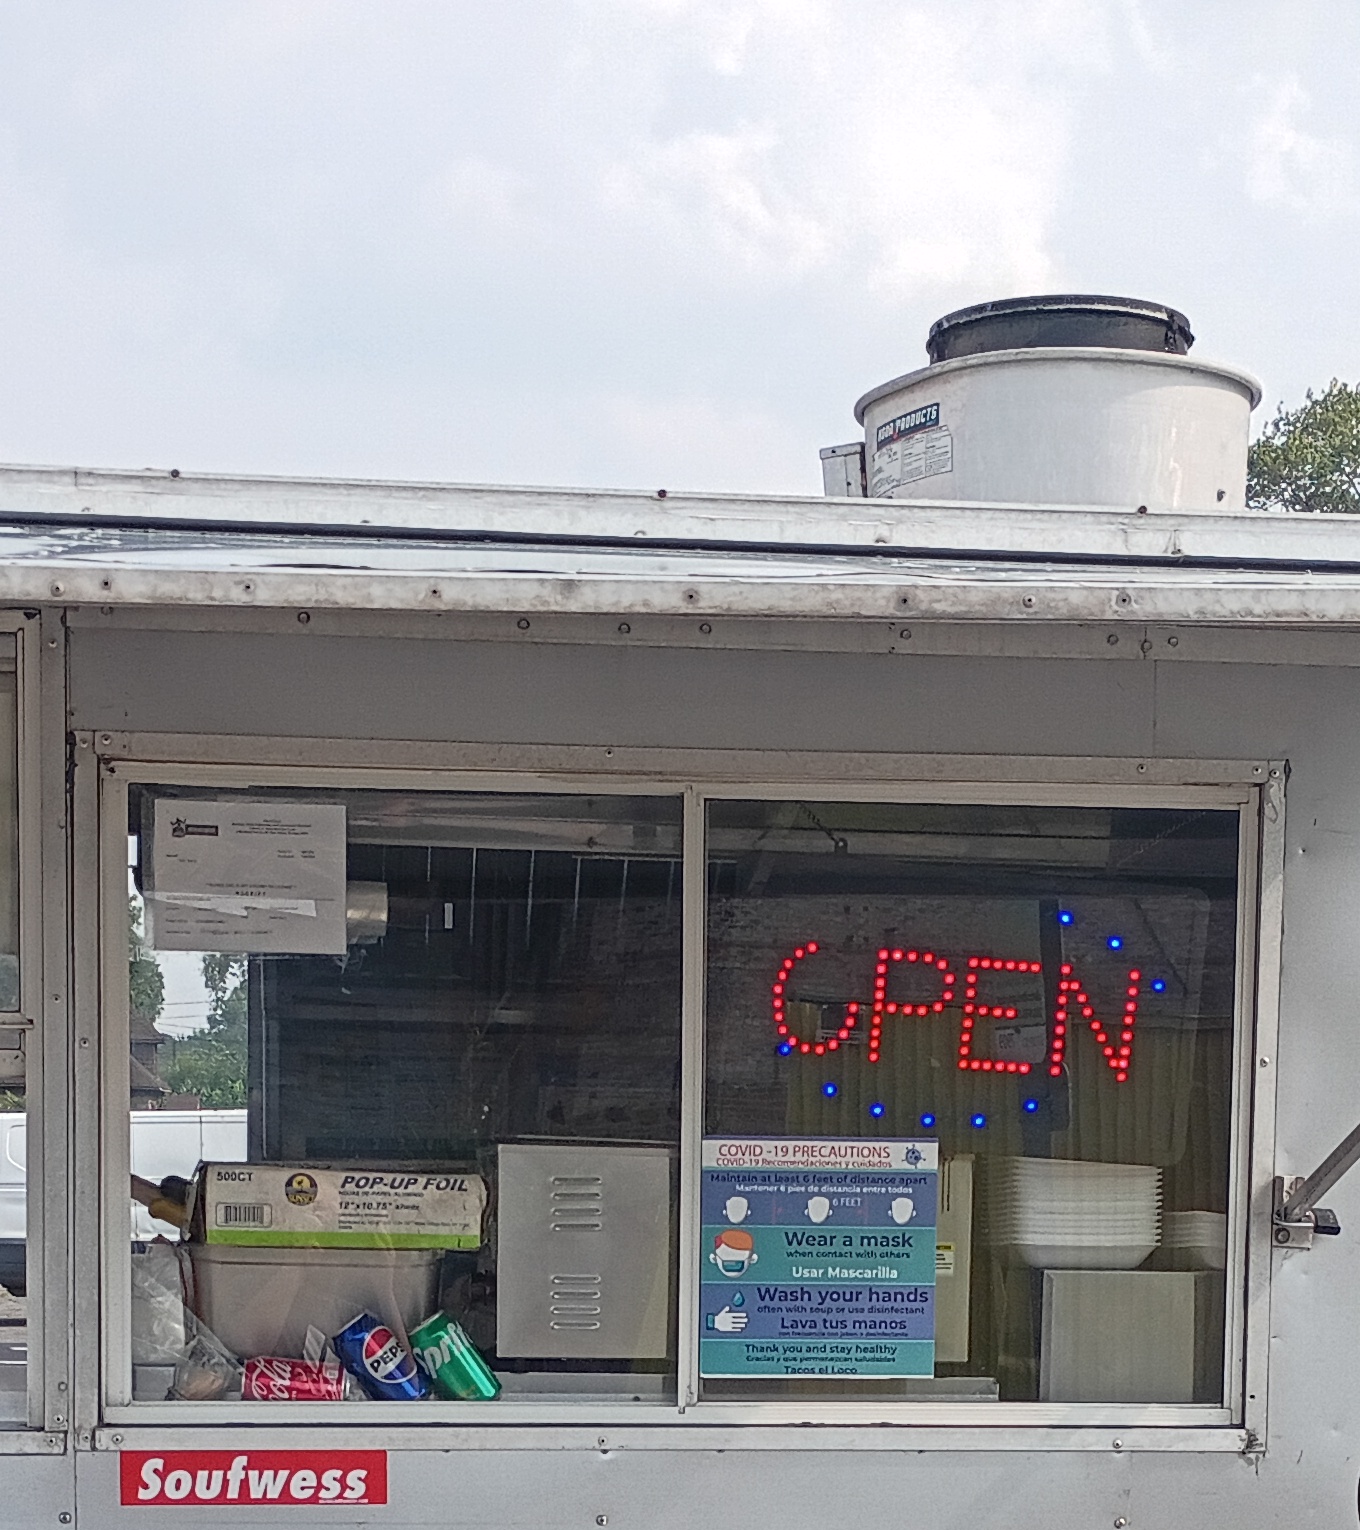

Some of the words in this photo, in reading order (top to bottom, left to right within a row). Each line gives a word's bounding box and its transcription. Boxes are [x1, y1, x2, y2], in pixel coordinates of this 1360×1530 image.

[772, 941, 1141, 1082] OPEN
[719, 1144, 763, 1157] COVID
[767, 1144, 788, 1157] -19
[793, 1145, 890, 1157] PRECAUTIONS
[716, 1158, 759, 1166] COVID-19
[216, 1172, 254, 1181] 500CT
[711, 1174, 757, 1183] Maintain
[760, 1174, 771, 1184] at
[775, 1174, 799, 1184] least
[803, 1174, 809, 1184] 6
[812, 1175, 834, 1184] feet
[837, 1175, 848, 1184] of
[850, 1175, 896, 1184] distance
[899, 1175, 927, 1186] apart
[341, 1175, 418, 1190] POP-UP
[423, 1177, 468, 1192] FOIL
[833, 1198, 838, 1206] 6
[840, 1198, 862, 1207] FEET
[785, 1232, 837, 1247] Wear
[842, 1236, 854, 1247] a
[860, 1232, 913, 1247] mask
[792, 1266, 823, 1278] Usar
[828, 1267, 898, 1278] Mascarilla
[757, 1287, 812, 1301] Wash
[818, 1291, 863, 1305] your
[868, 1288, 928, 1302] hands
[868, 1306, 924, 1314] disinfectant
[781, 1318, 817, 1329] Lava
[823, 1318, 847, 1329] tus
[853, 1320, 907, 1329] manos
[745, 1344, 779, 1353] Thank
[782, 1346, 803, 1355] you
[806, 1344, 826, 1353] and
[829, 1344, 853, 1356] stay
[855, 1344, 898, 1356] healthy
[370, 1341, 405, 1373] PEPS
[784, 1366, 816, 1374] Tacos
[819, 1366, 829, 1374] el
[831, 1366, 857, 1374] Loco
[138, 1456, 368, 1503] Soufwess
